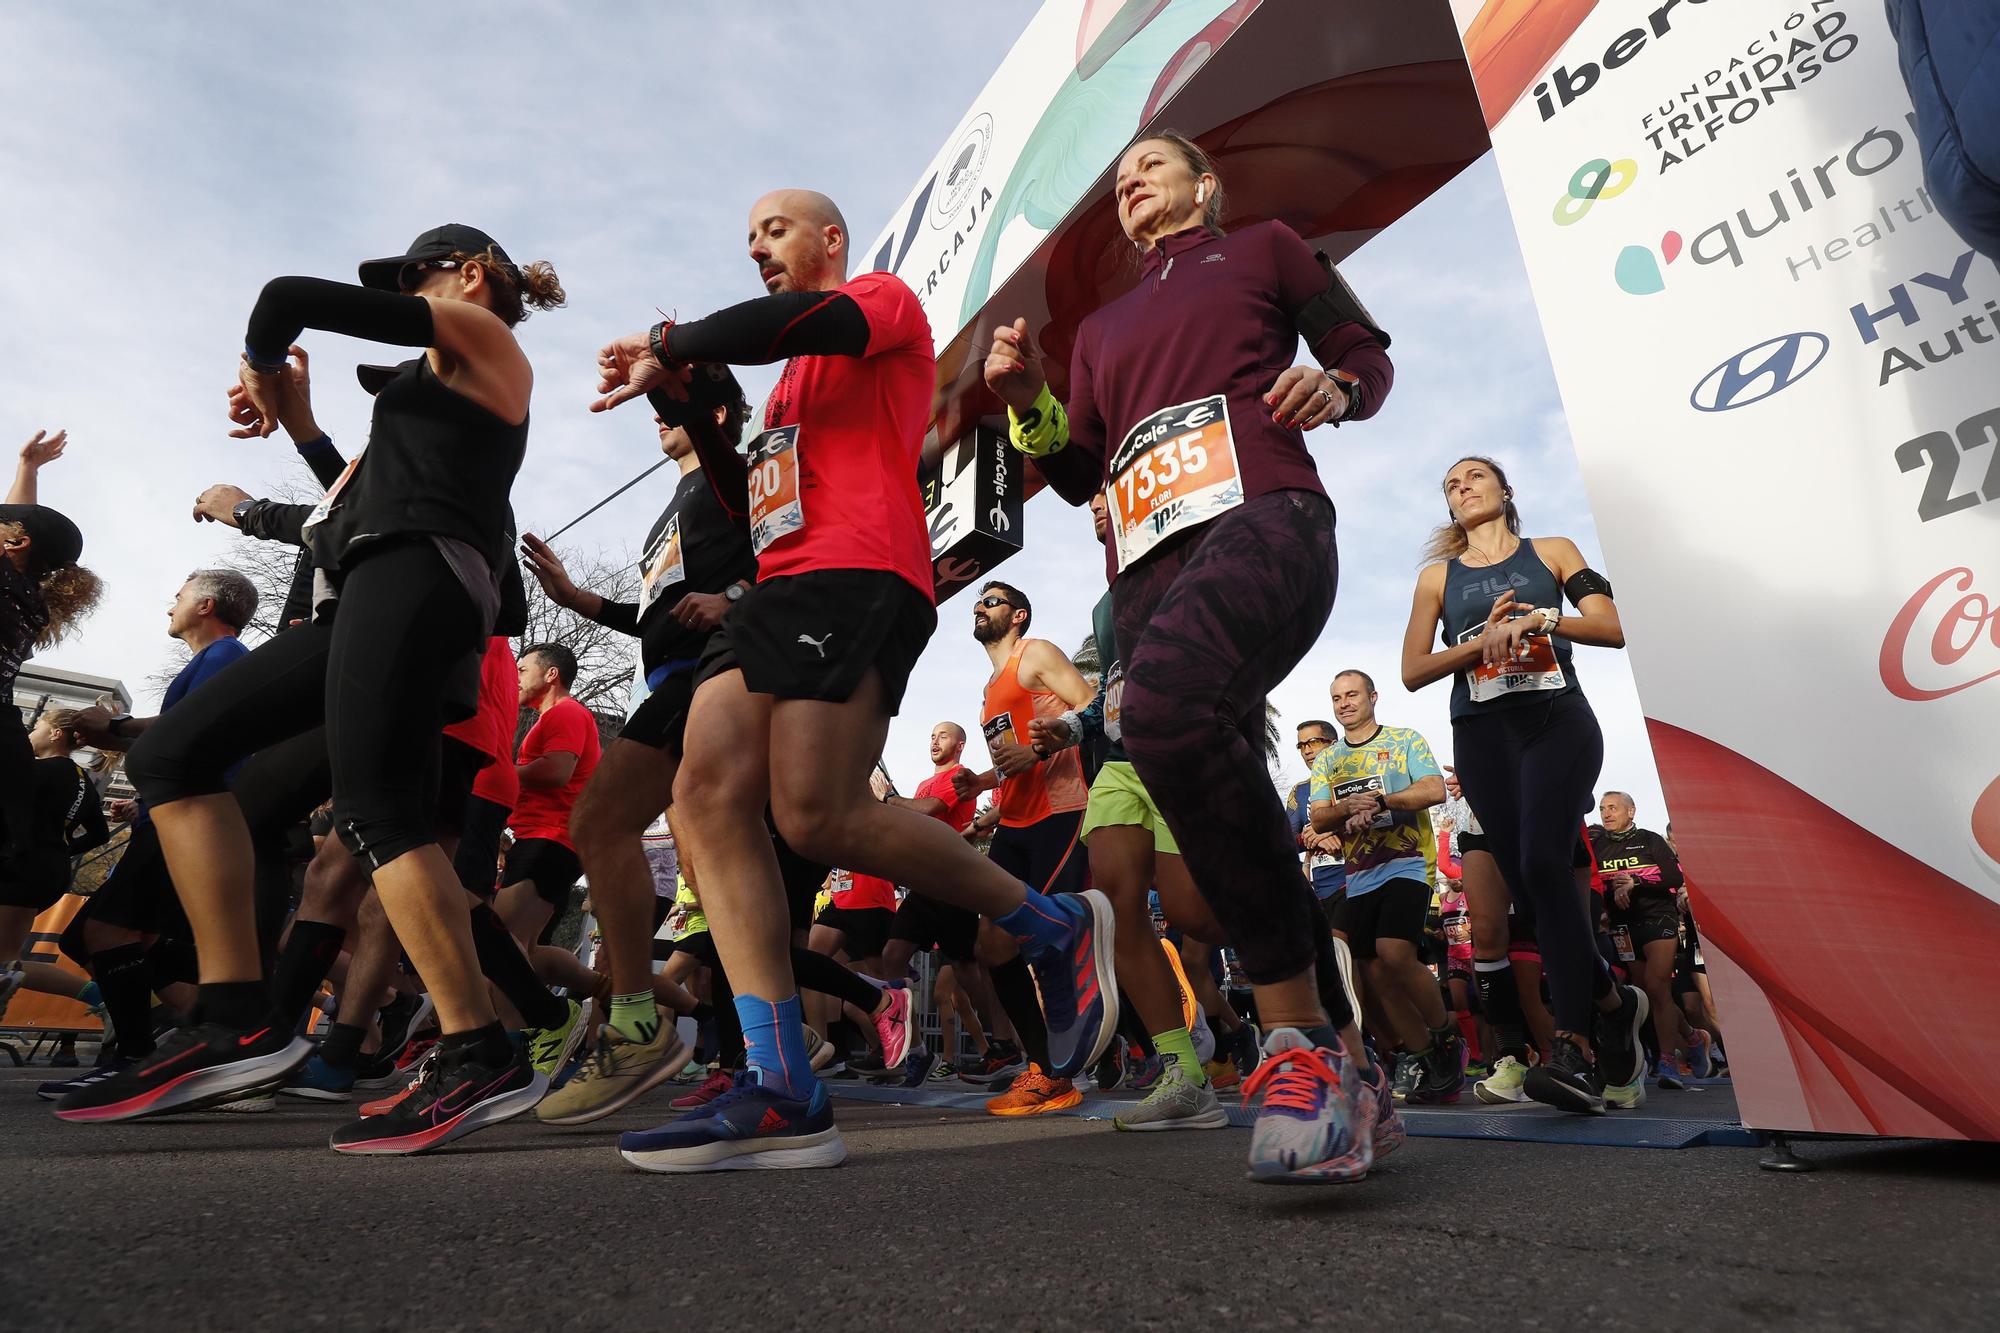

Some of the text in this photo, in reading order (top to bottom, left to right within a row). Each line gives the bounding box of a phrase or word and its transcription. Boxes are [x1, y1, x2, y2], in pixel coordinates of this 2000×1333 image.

[1533, 0, 1708, 122] iber
[1645, 11, 1847, 150] TRINIDAD
[1660, 34, 1858, 175] ALFONSO
[1690, 112, 1917, 267] quiró
[1120, 430, 1209, 514] 7335
[1150, 489, 1172, 508] FLORI
[1463, 572, 1529, 600] FILA
[1497, 665, 1524, 674] VICTORIA
